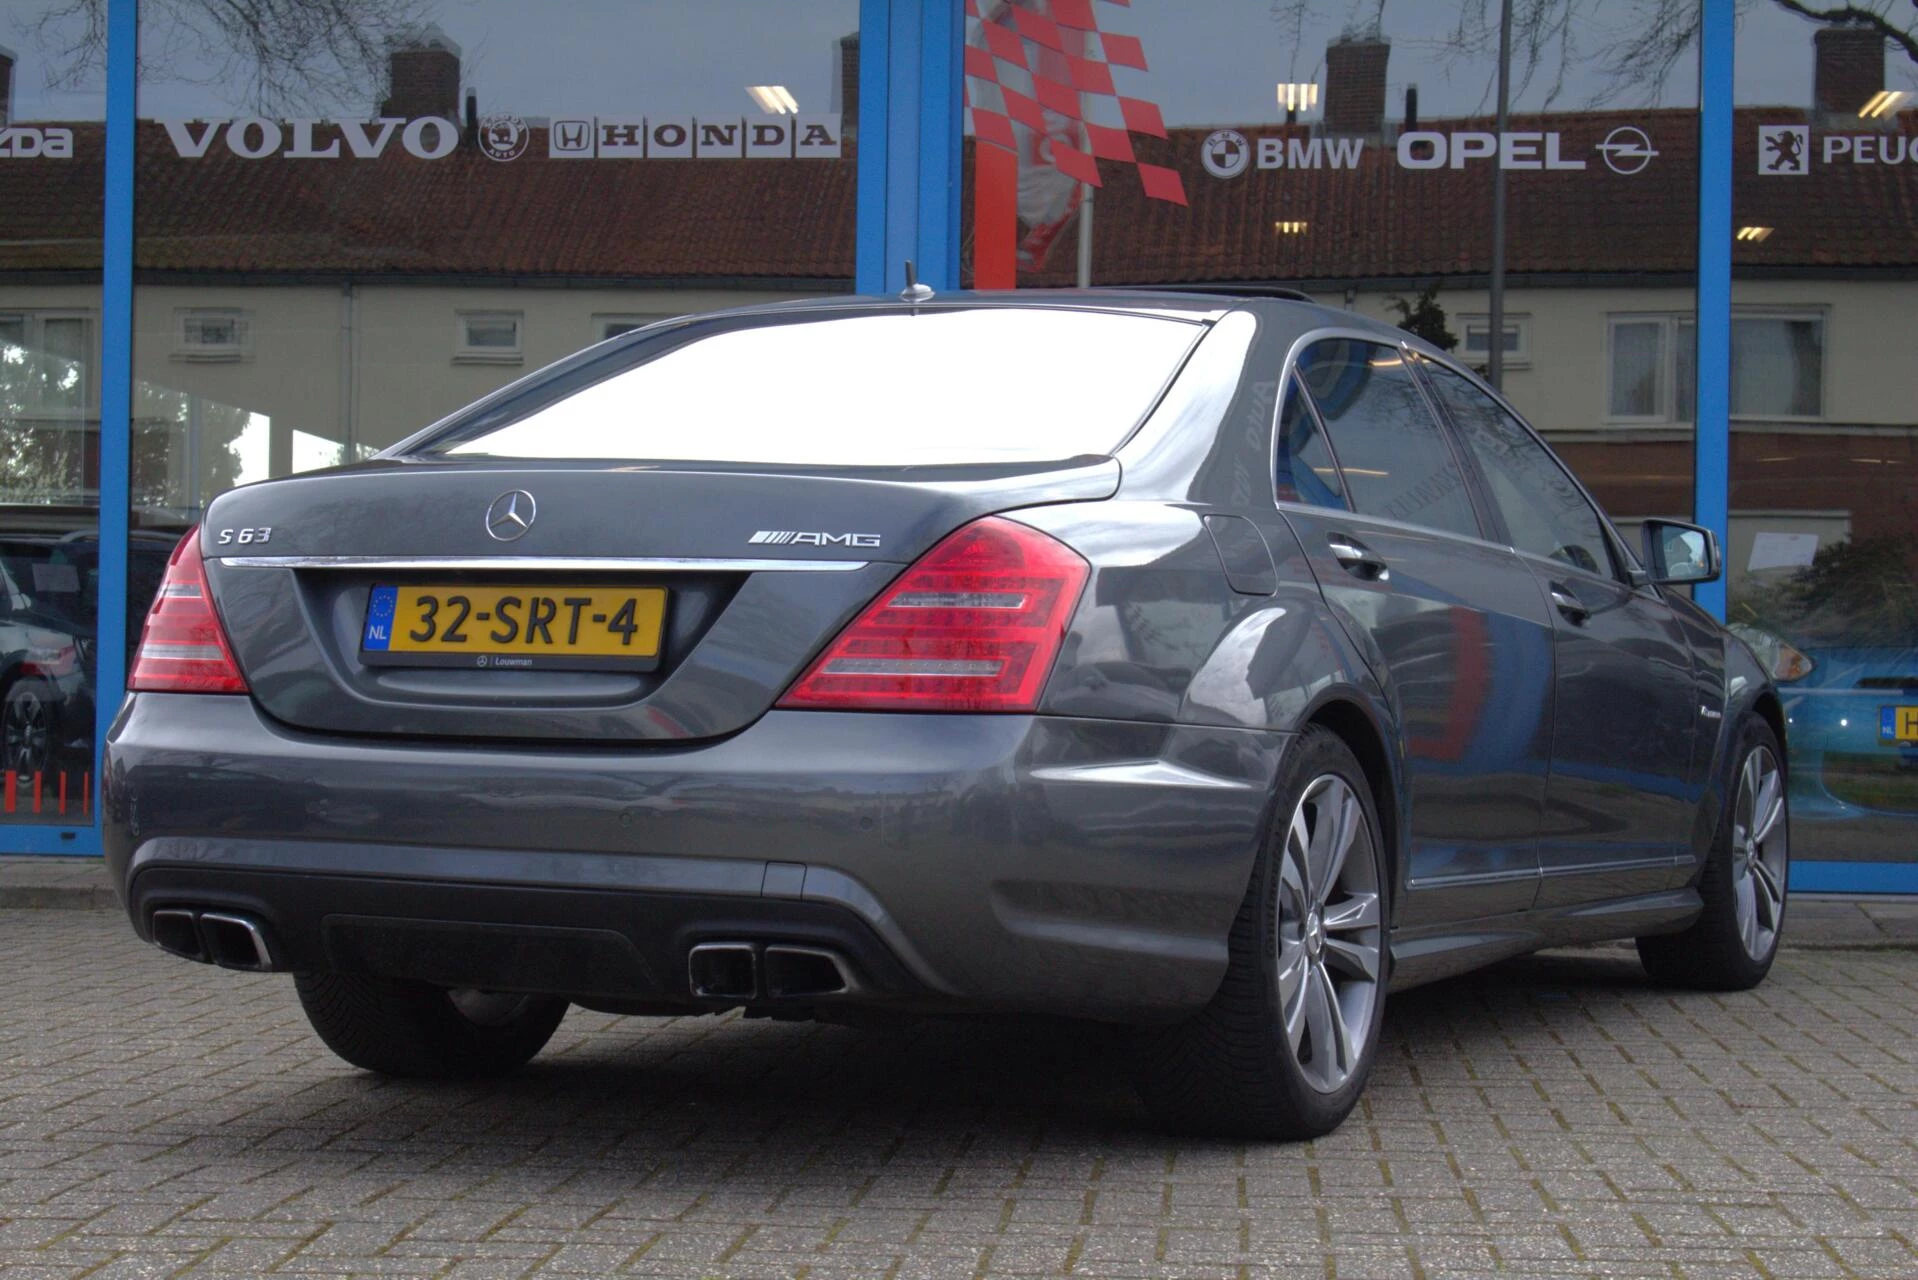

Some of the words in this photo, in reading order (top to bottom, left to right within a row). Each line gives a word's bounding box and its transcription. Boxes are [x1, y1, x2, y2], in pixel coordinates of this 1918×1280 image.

[154, 116, 460, 160] VOLVO
[601, 124, 838, 148] HONDA
[1397, 131, 1587, 170] OPEL
[1257, 138, 1364, 169] BMW
[217, 528, 234, 545] S
[237, 527, 272, 544] 63
[368, 625, 387, 640] NL
[410, 595, 638, 646] 32-SRT-4
